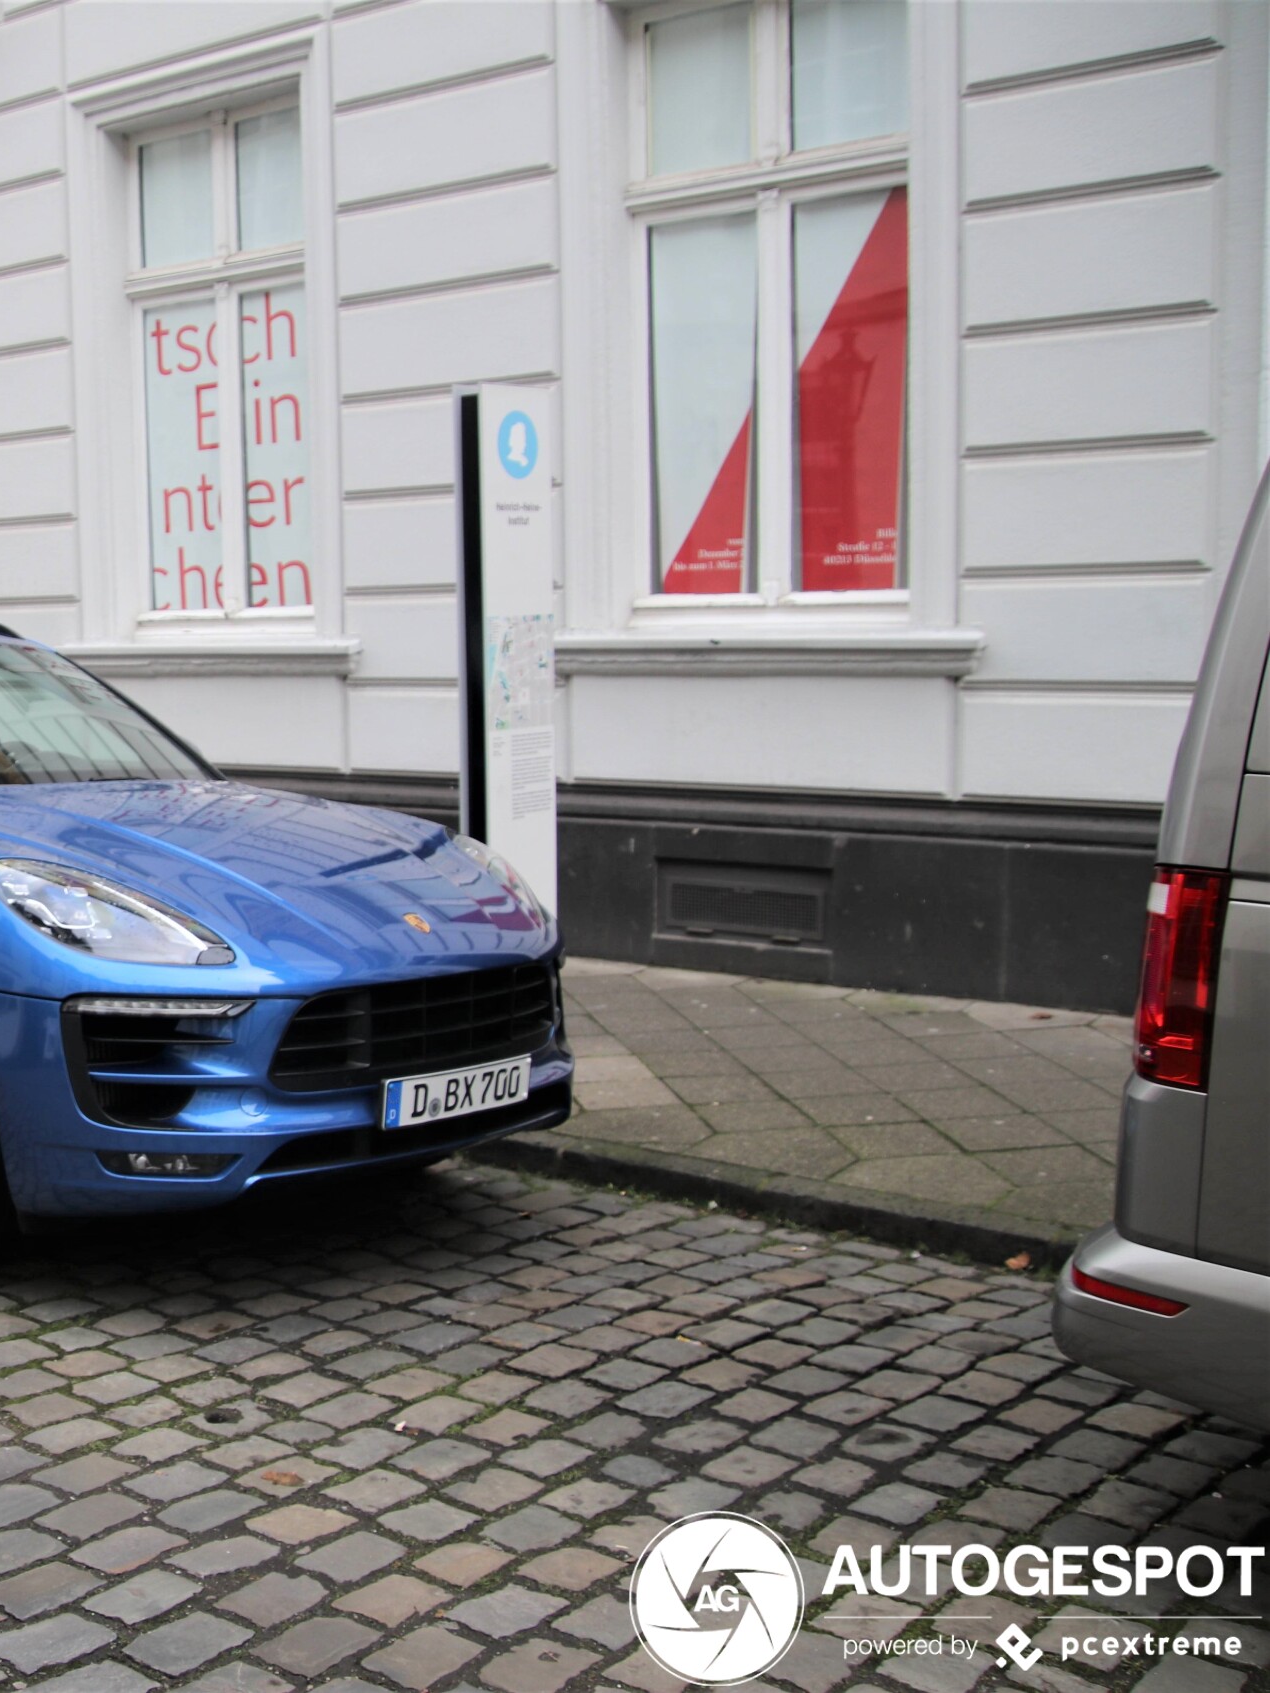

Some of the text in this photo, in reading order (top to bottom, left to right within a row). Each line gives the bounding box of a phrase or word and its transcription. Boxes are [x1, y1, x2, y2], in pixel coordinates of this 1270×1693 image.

[150, 290, 297, 376] tsch
[195, 379, 302, 451] Ein
[163, 473, 306, 533] nter
[411, 1083, 428, 1118] D
[444, 1074, 477, 1112] BX
[481, 1065, 520, 1104] 700
